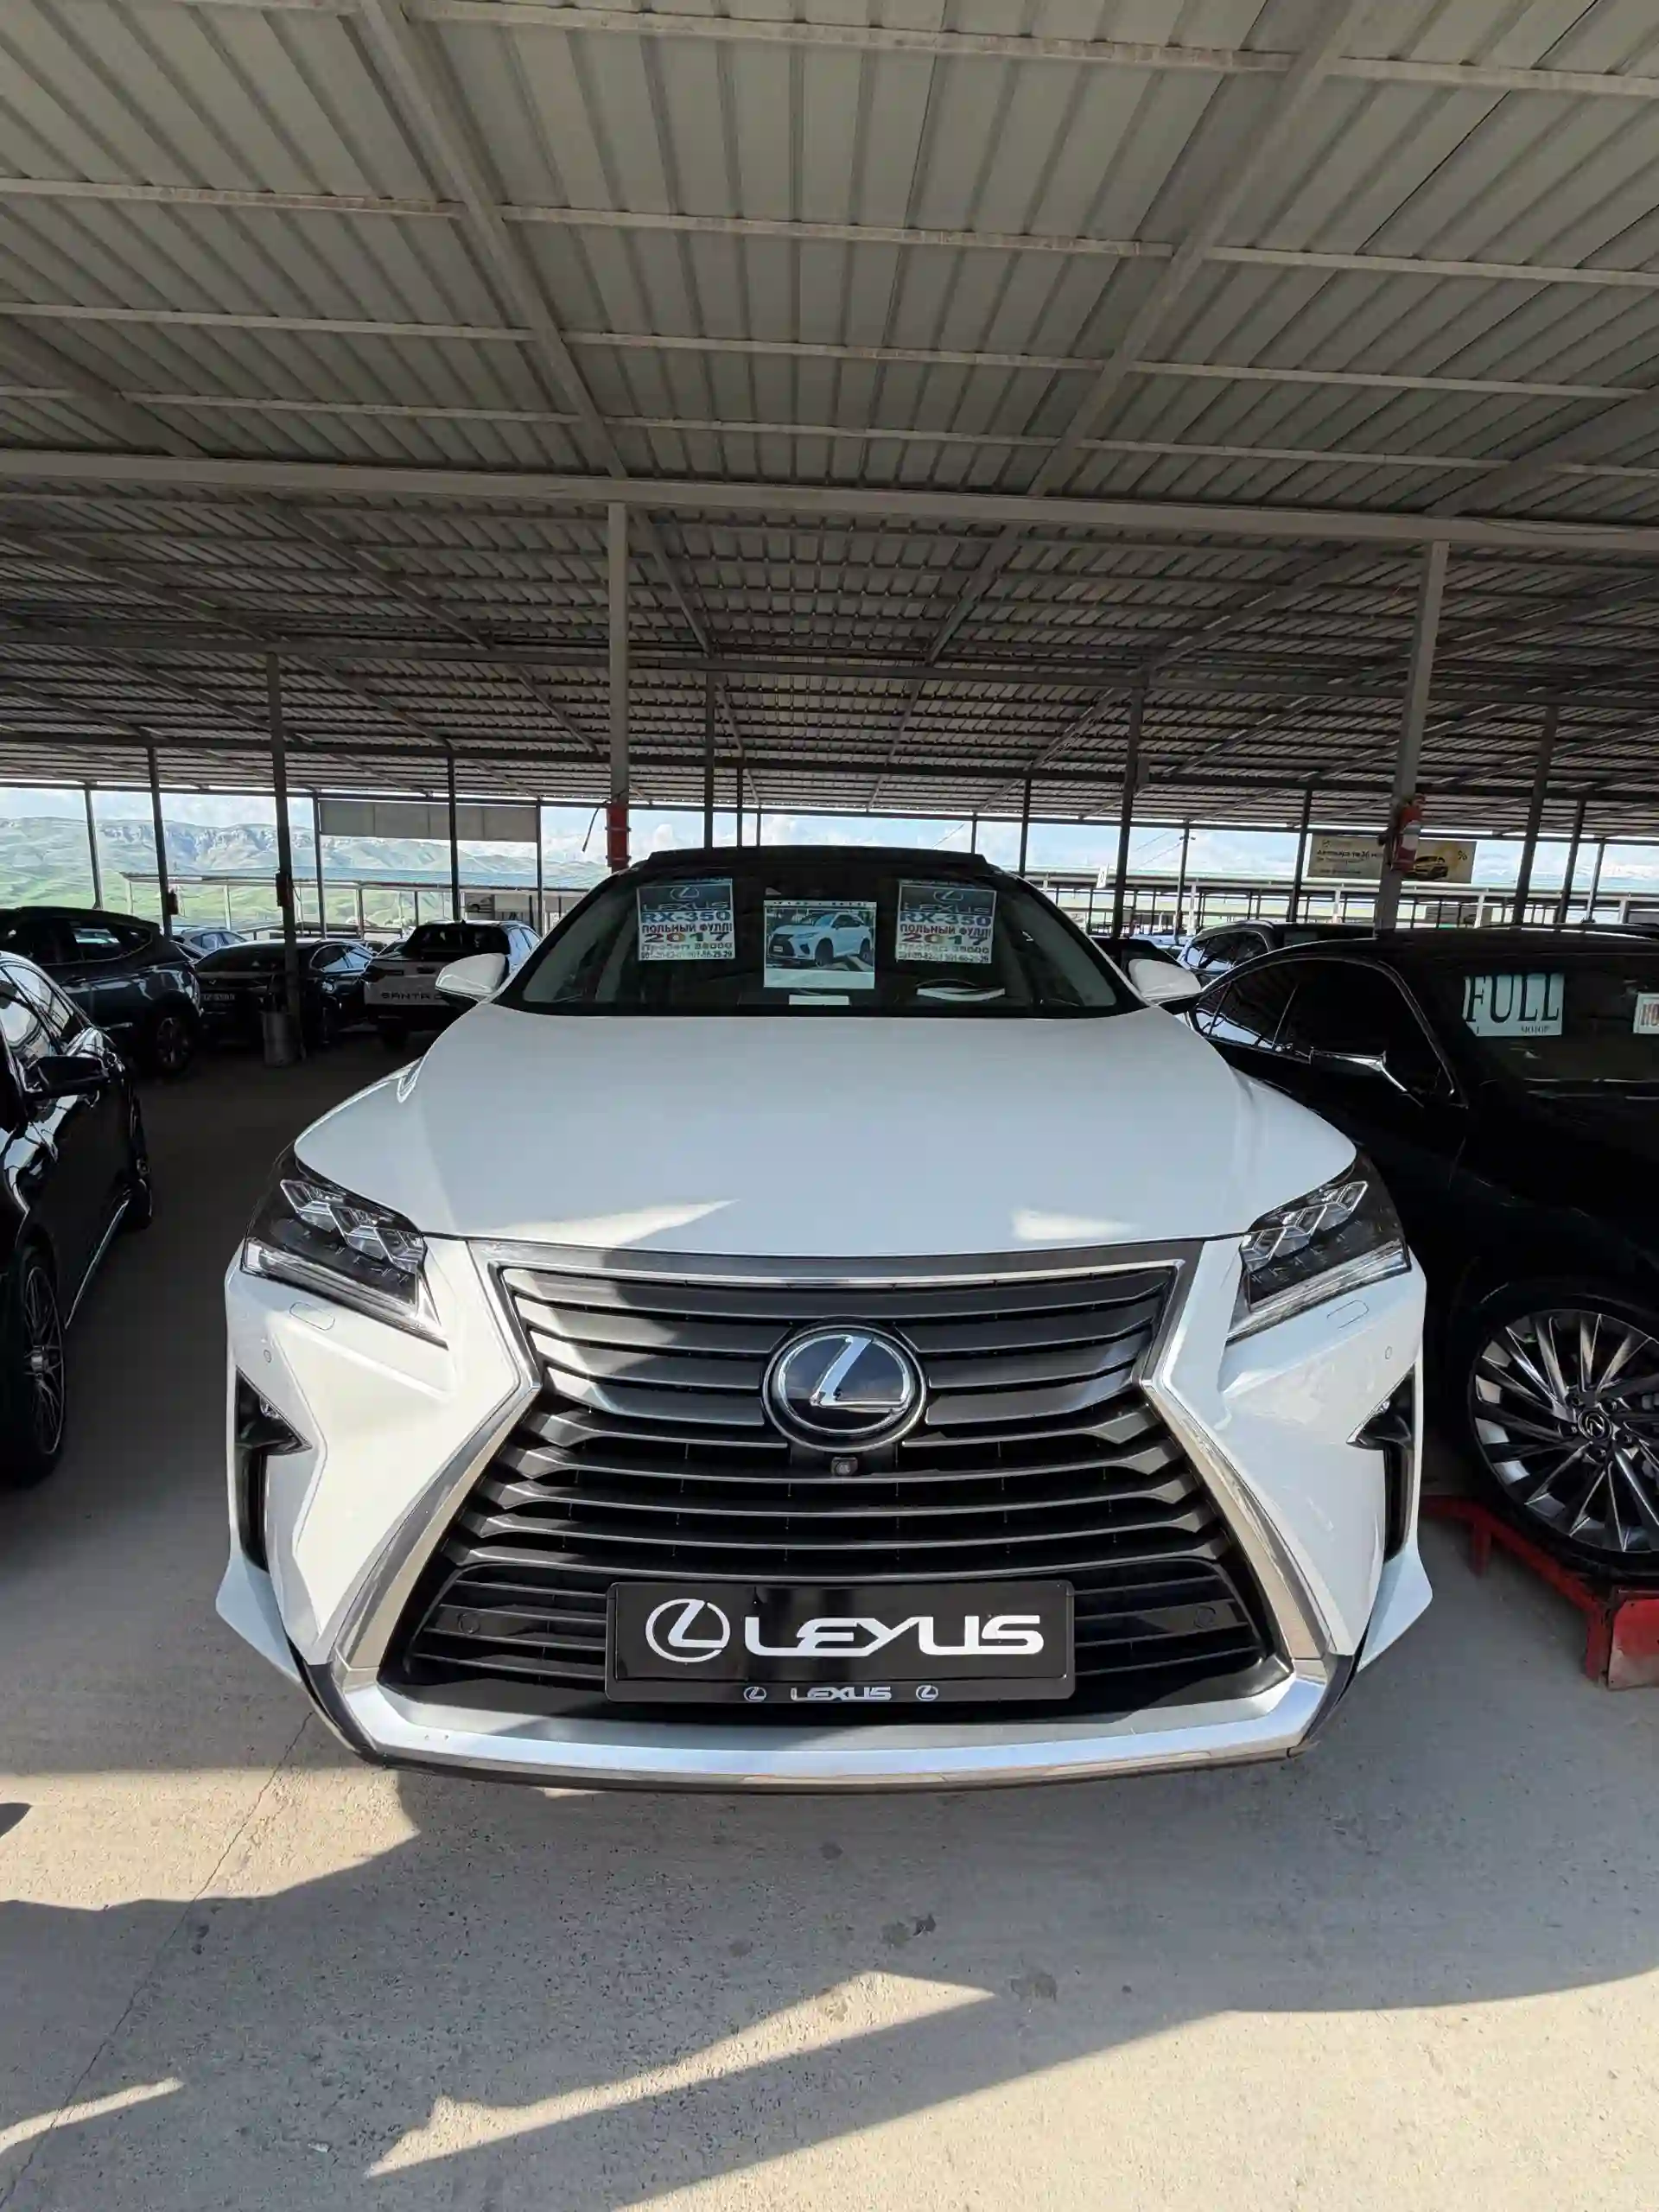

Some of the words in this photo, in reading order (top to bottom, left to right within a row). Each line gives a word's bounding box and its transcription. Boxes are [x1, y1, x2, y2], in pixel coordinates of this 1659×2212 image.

[642, 902, 730, 912] LEXUS
[903, 902, 990, 915] LEXUS
[642, 911, 731, 923] RX-350
[899, 912, 992, 926] RX-350
[644, 931, 729, 944] 2017
[901, 932, 988, 946] 2017
[380, 992, 430, 1001] SANTA
[1464, 974, 1560, 1023] FULL
[744, 1614, 1045, 1657] LEXUS
[790, 1685, 893, 1702] LEXUS
